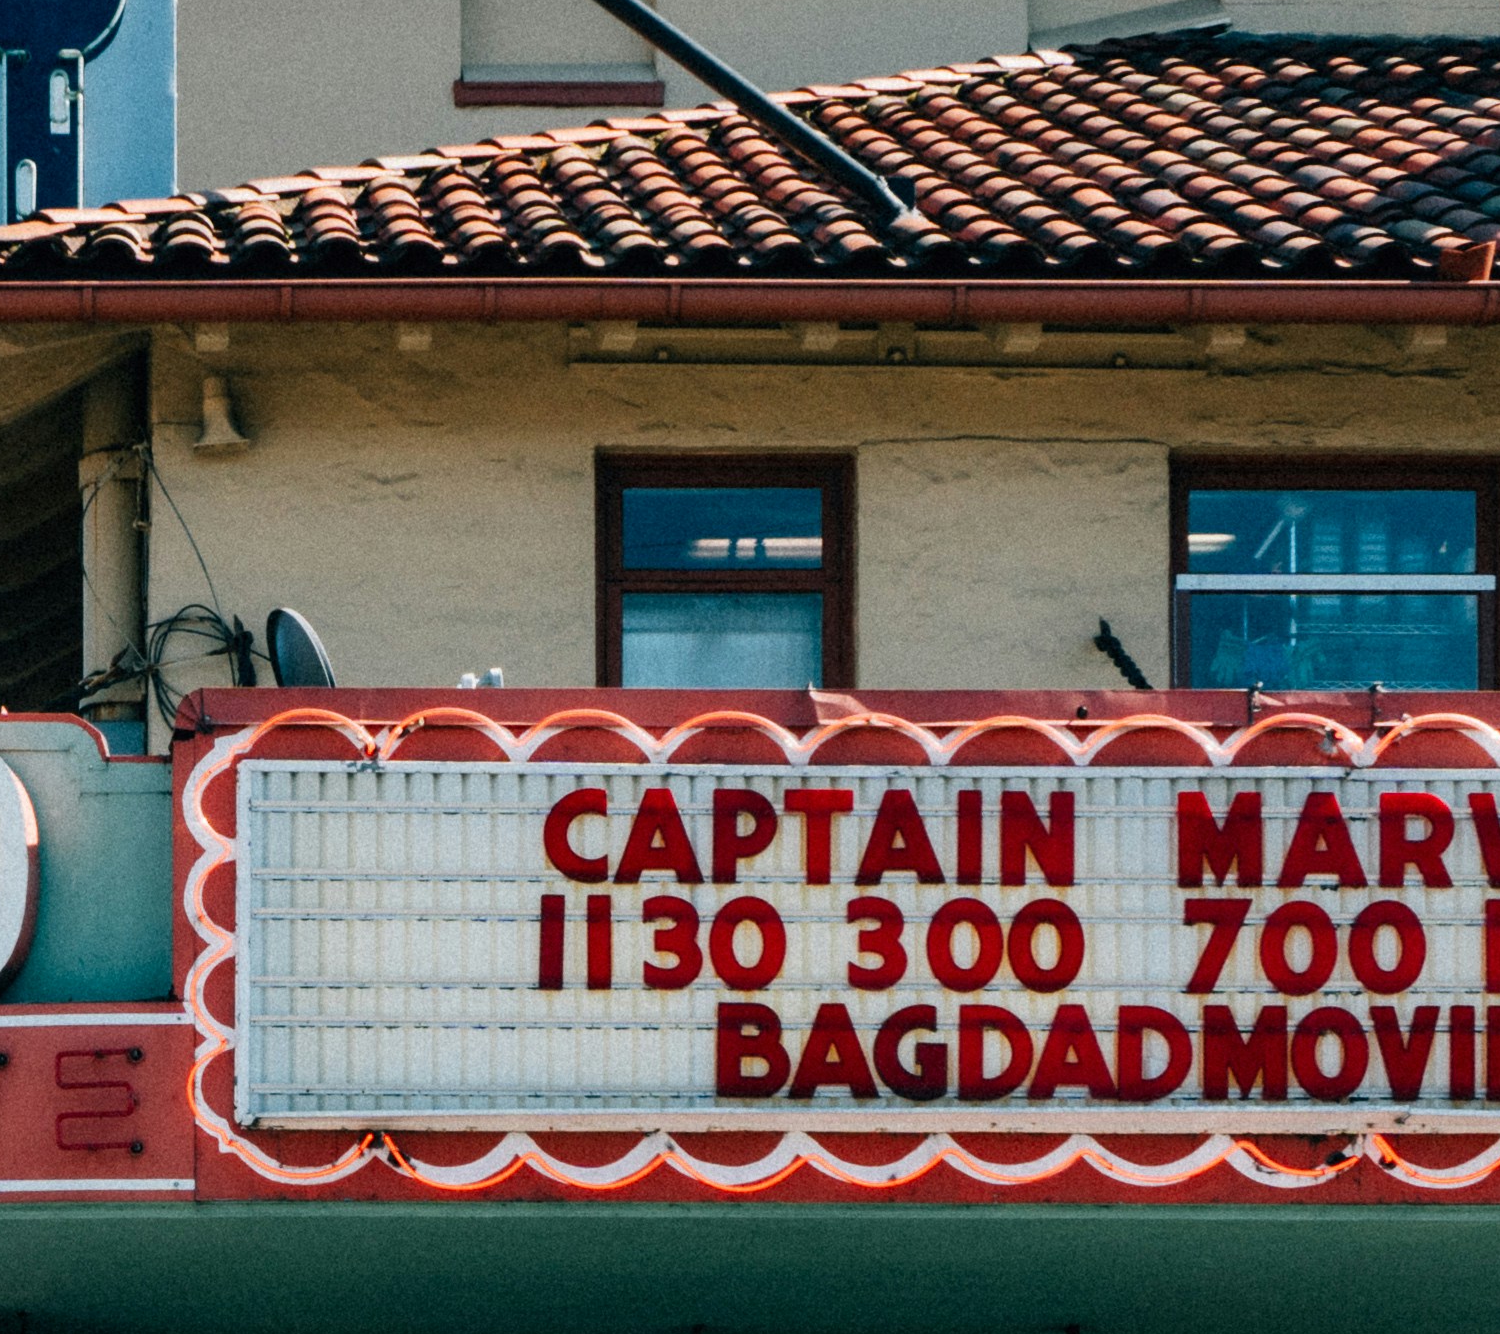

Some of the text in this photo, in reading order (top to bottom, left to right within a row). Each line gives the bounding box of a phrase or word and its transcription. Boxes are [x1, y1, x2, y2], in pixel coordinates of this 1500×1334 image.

[543, 788, 1075, 888] CAPTAIN
[538, 894, 787, 992] 1130
[846, 896, 1085, 994] 300
[1183, 898, 1427, 995] 700
